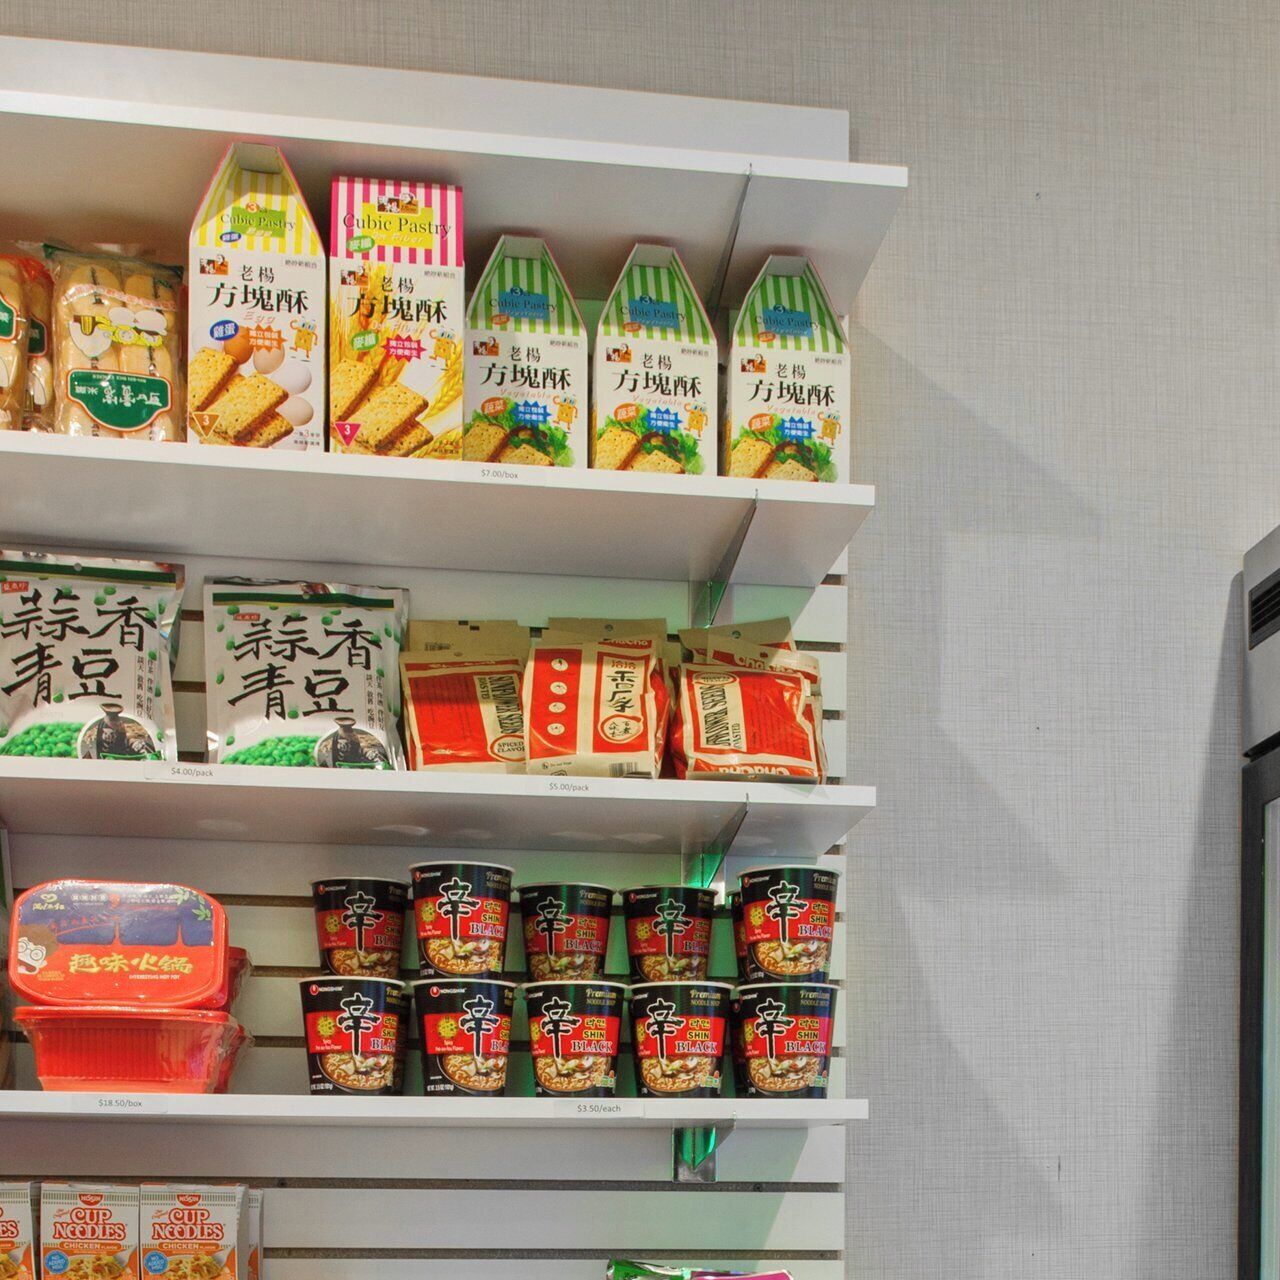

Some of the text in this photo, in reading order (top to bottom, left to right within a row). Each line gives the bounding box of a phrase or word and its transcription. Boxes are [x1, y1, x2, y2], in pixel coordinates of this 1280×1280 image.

[258, 214, 296, 231] Pastry
[343, 215, 452, 238] Cubic Pastry
[240, 264, 274, 283] 老楊
[381, 276, 414, 294] 老楊
[206, 282, 309, 315] 方塊酥
[347, 293, 448, 324] 方塊酥
[479, 362, 572, 390] 方塊酥
[612, 371, 702, 398] 方塊酥
[746, 380, 835, 407] 方塊酥
[480, 470, 519, 480] $7.00/box
[1, 588, 158, 651] 蒜香
[234, 615, 385, 670] 蒜香
[1, 642, 123, 707] 青豆
[228, 663, 354, 720] 青豆
[170, 766, 214, 777] $4.00/pack
[548, 782, 589, 793] $5.00/pack
[437, 877, 480, 943] 辛
[765, 881, 808, 944] 辛
[584, 1031, 604, 1040] SHIN
[646, 998, 684, 1061] 辛
[688, 1031, 709, 1040] SHIN
[756, 998, 793, 1061] 辛
[798, 1031, 818, 1040] SHIN
[572, 1041, 612, 1053] BLACK
[677, 1041, 717, 1053] BLACK
[786, 1041, 826, 1053] BLACK
[98, 1099, 143, 1108] $18.50/box
[577, 1104, 621, 1114] $3.50/each
